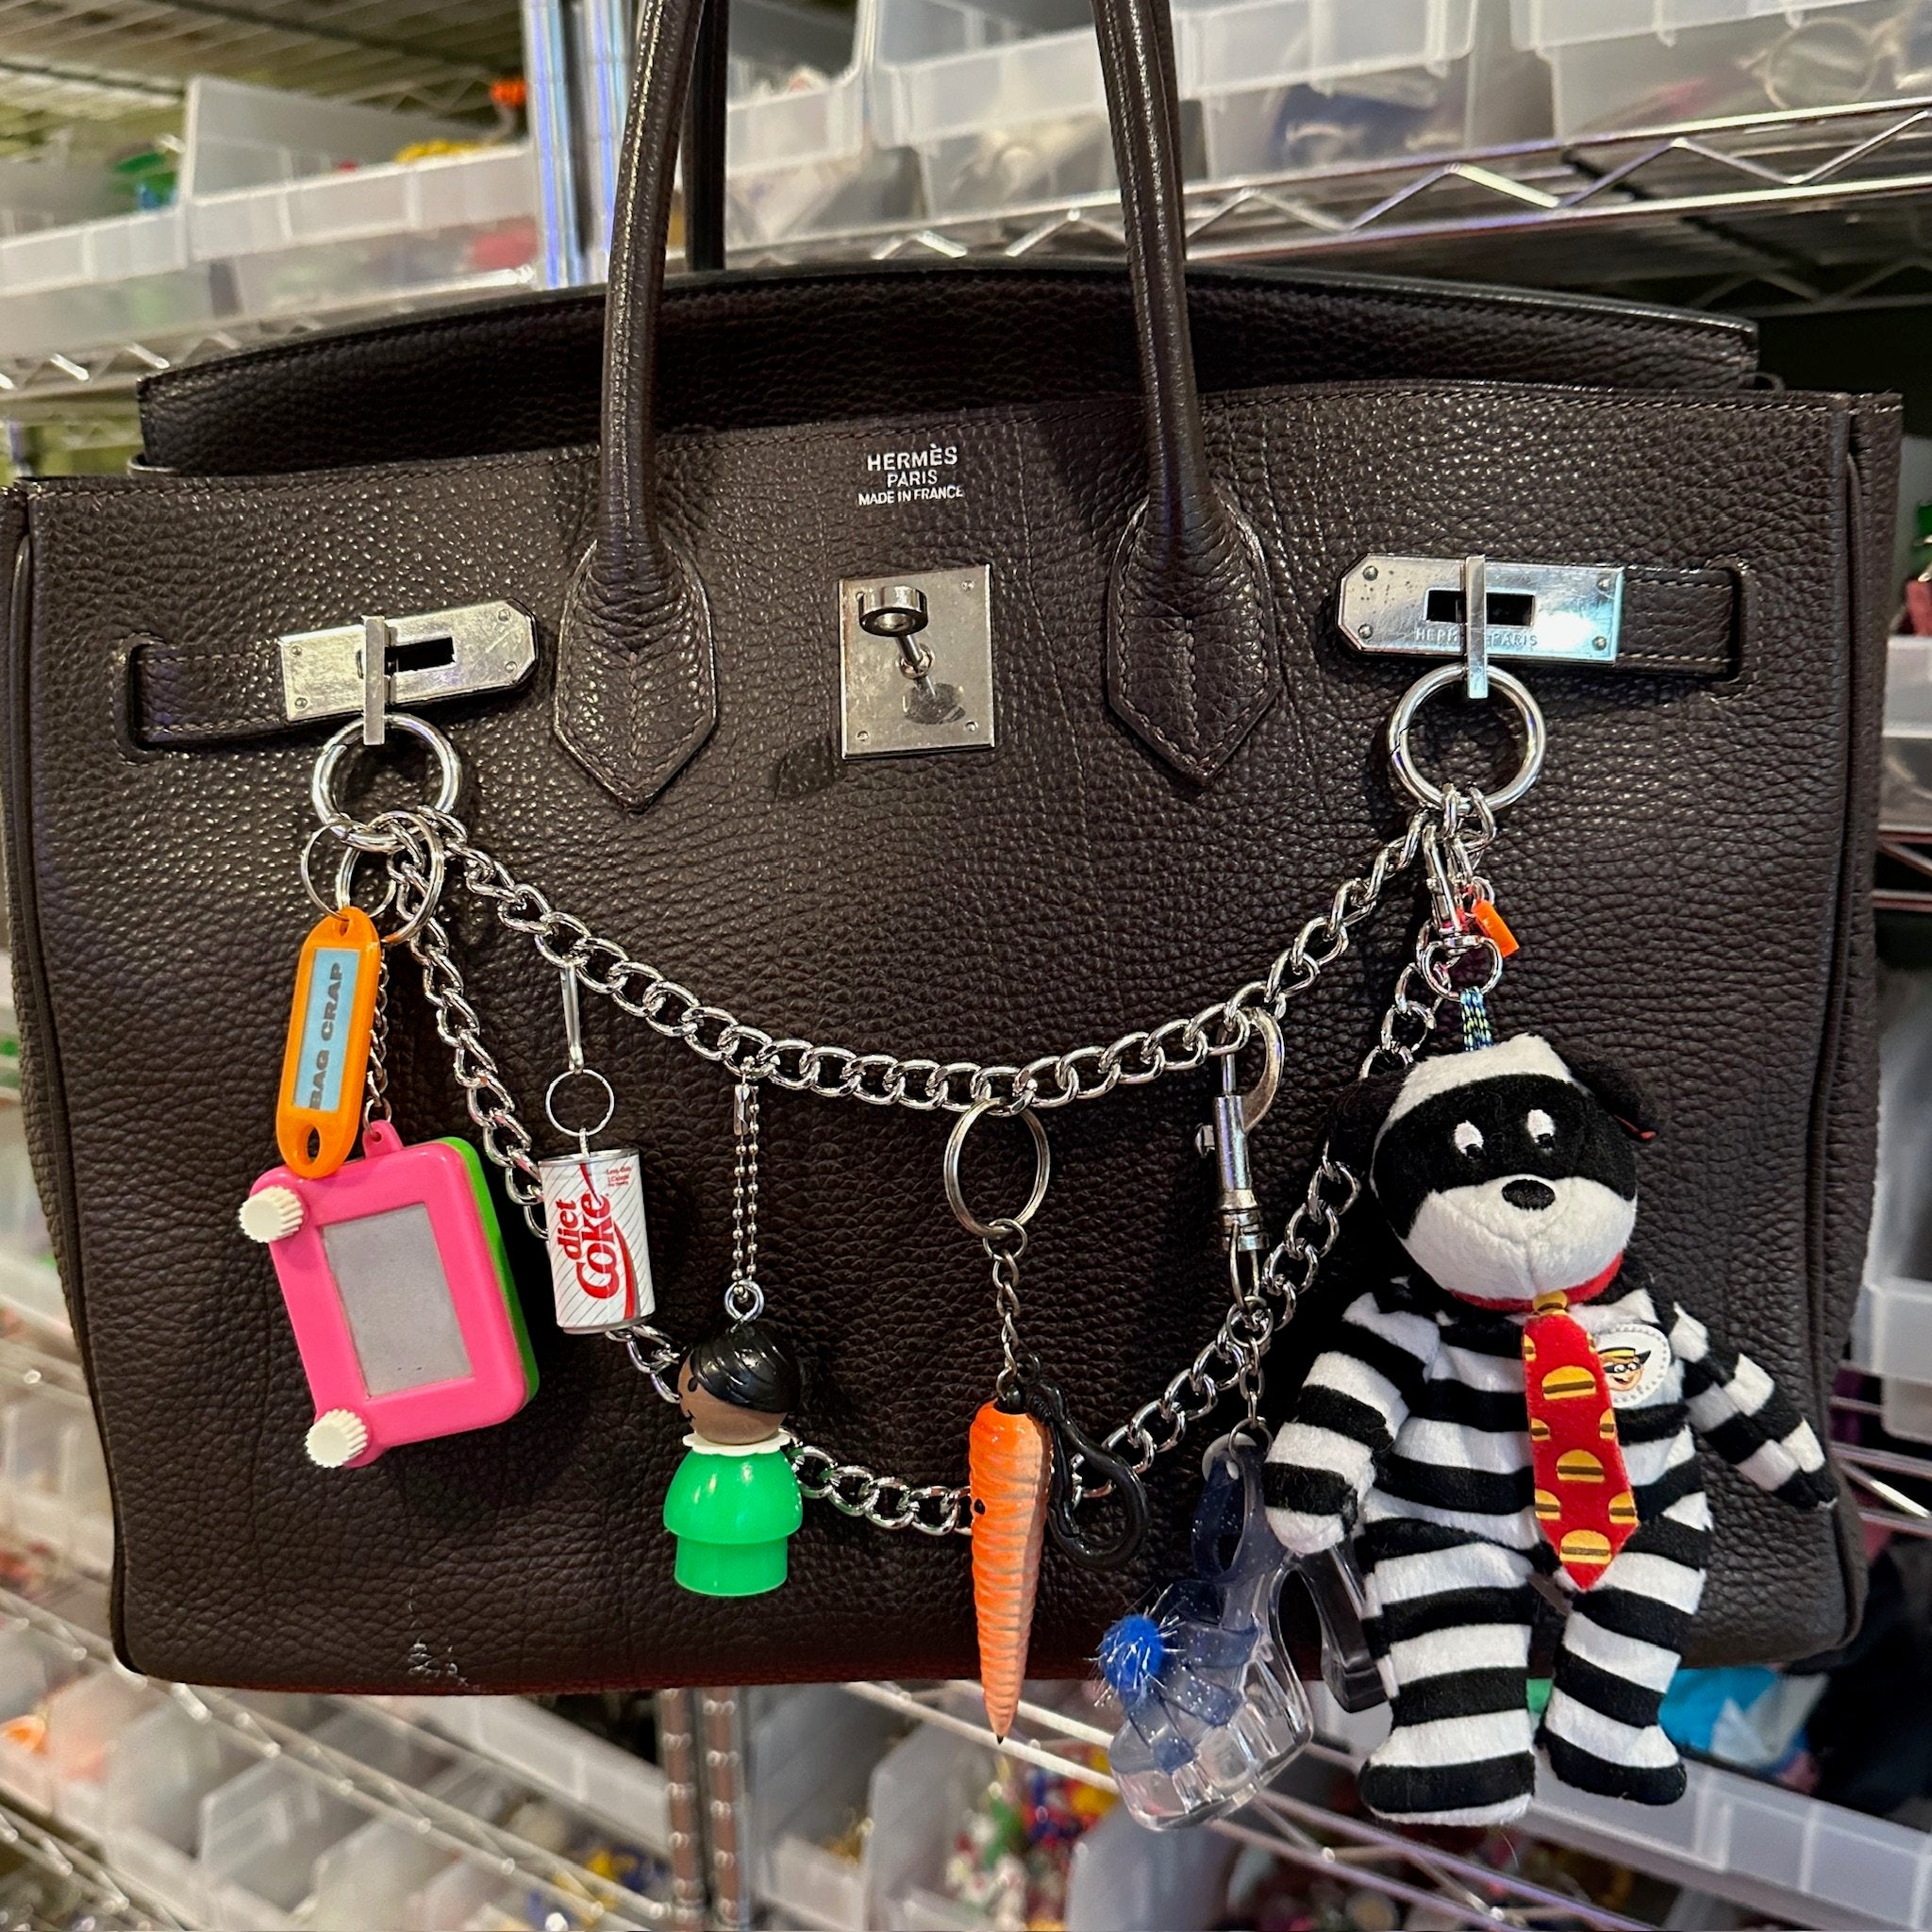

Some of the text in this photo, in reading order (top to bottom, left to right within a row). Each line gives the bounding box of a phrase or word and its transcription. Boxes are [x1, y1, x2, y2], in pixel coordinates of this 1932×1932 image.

[867, 442, 958, 472] HERMÈS
[887, 469, 939, 488] PARIS
[858, 484, 965, 507] MADE IN FRANCE
[308, 961, 343, 1110] BAG CRAP
[555, 1198, 583, 1261] diet
[575, 1192, 621, 1300] Coke
